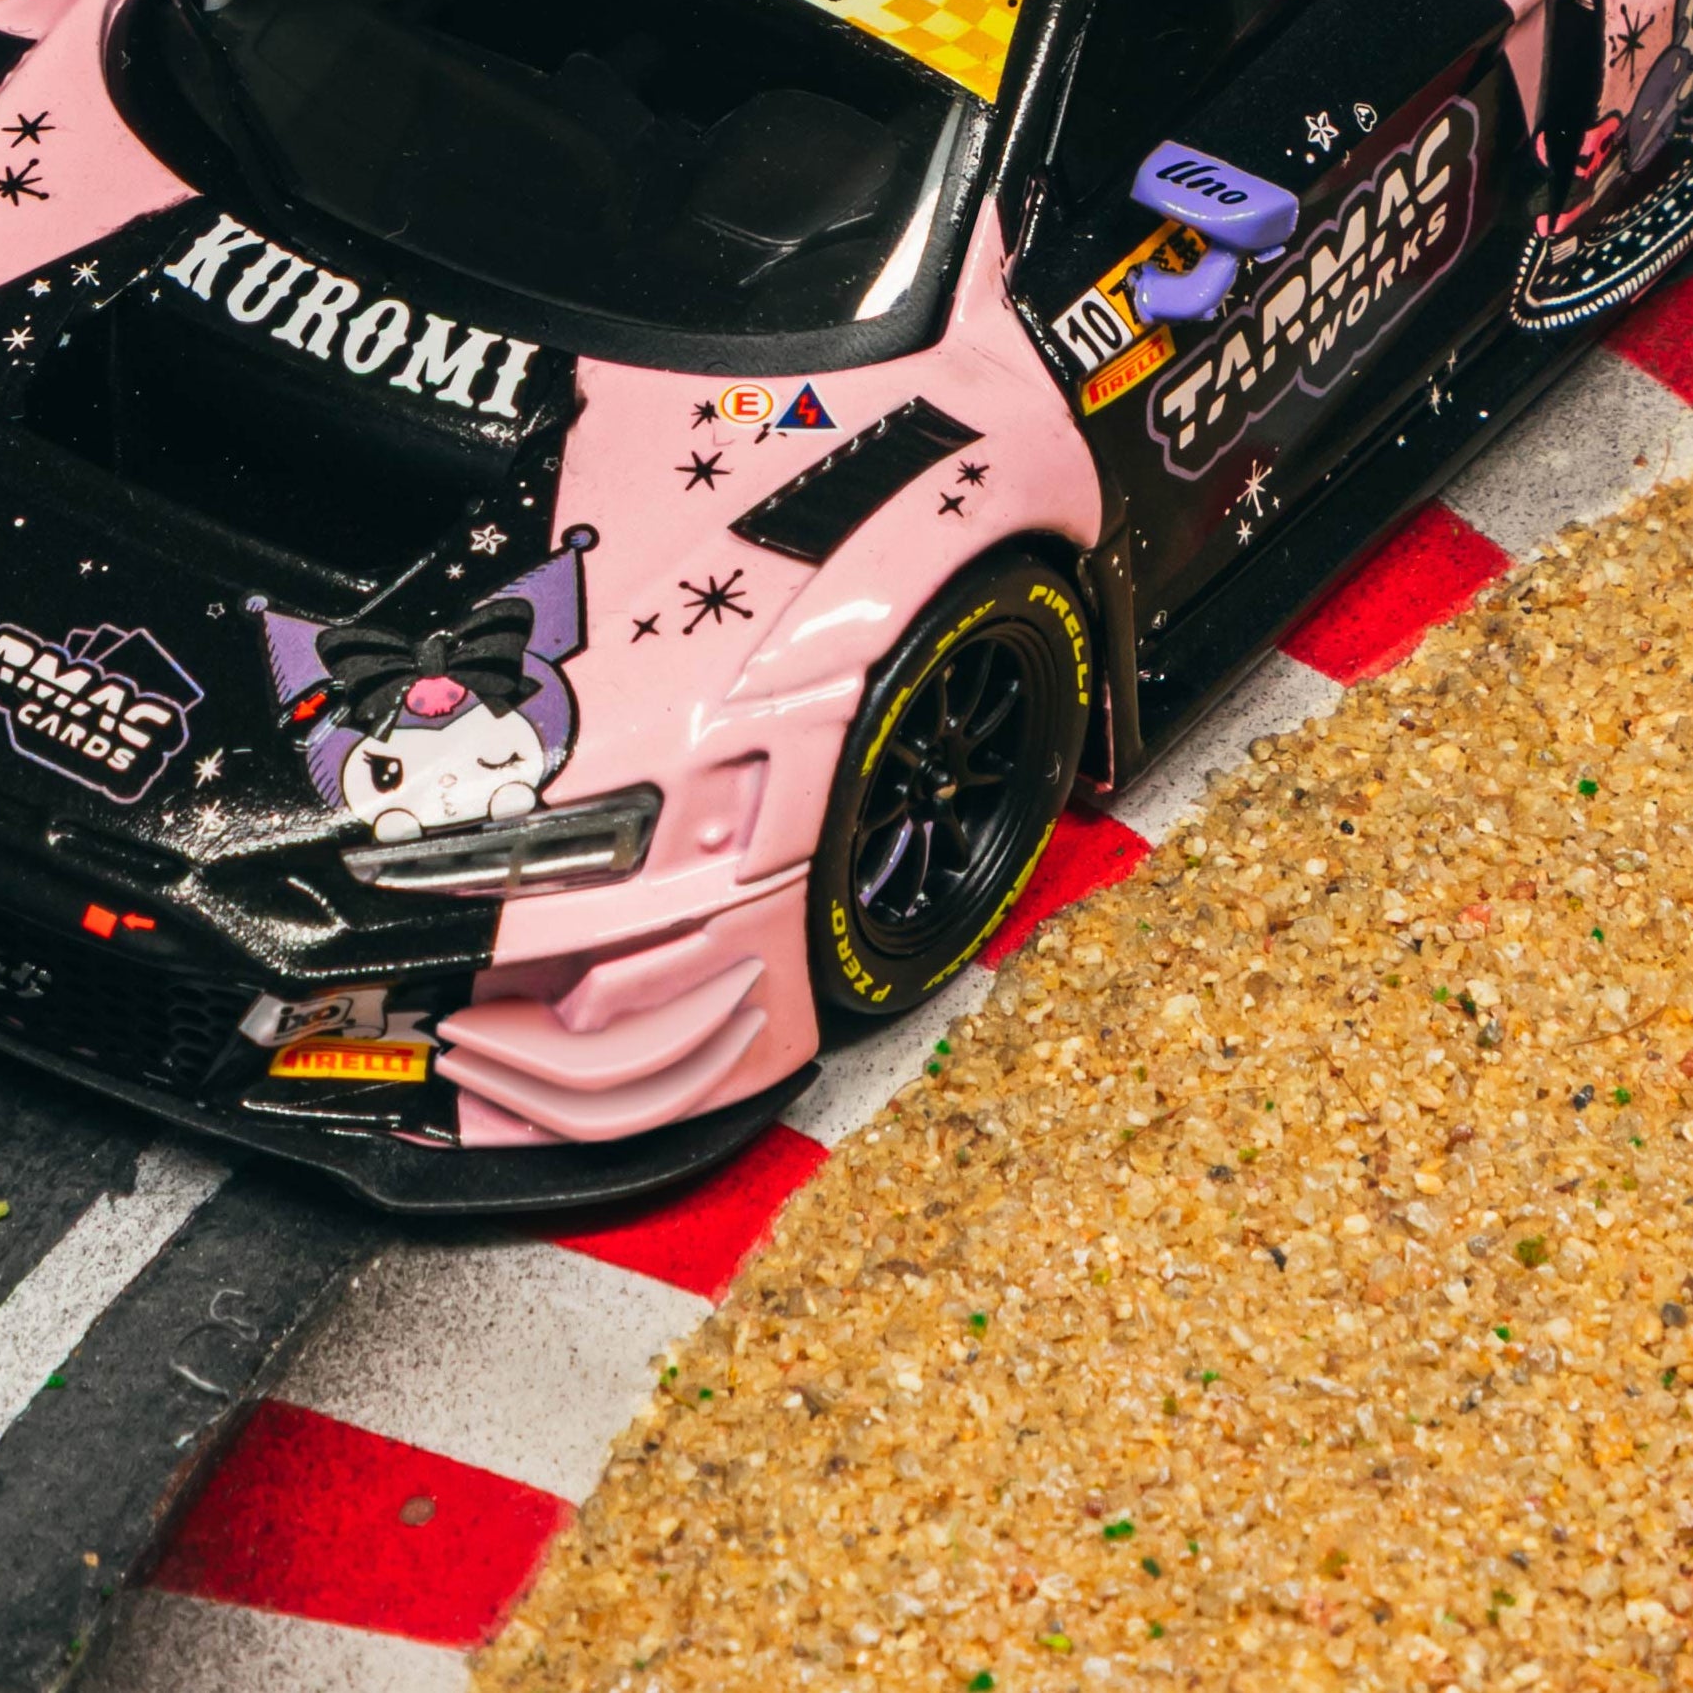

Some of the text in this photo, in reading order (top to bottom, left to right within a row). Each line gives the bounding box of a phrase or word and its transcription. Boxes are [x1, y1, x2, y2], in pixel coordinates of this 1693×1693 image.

[163, 212, 541, 418] KUROMI
[1066, 299, 1124, 364] 10
[1162, 116, 1451, 450] TARMAC
[1308, 201, 1448, 366] WORKS
[1087, 333, 1166, 406] PIRELLI
[1028, 584, 1089, 706] PIRELLI
[17, 703, 136, 772] CARDS
[282, 1042, 414, 1073] PIRELLI
